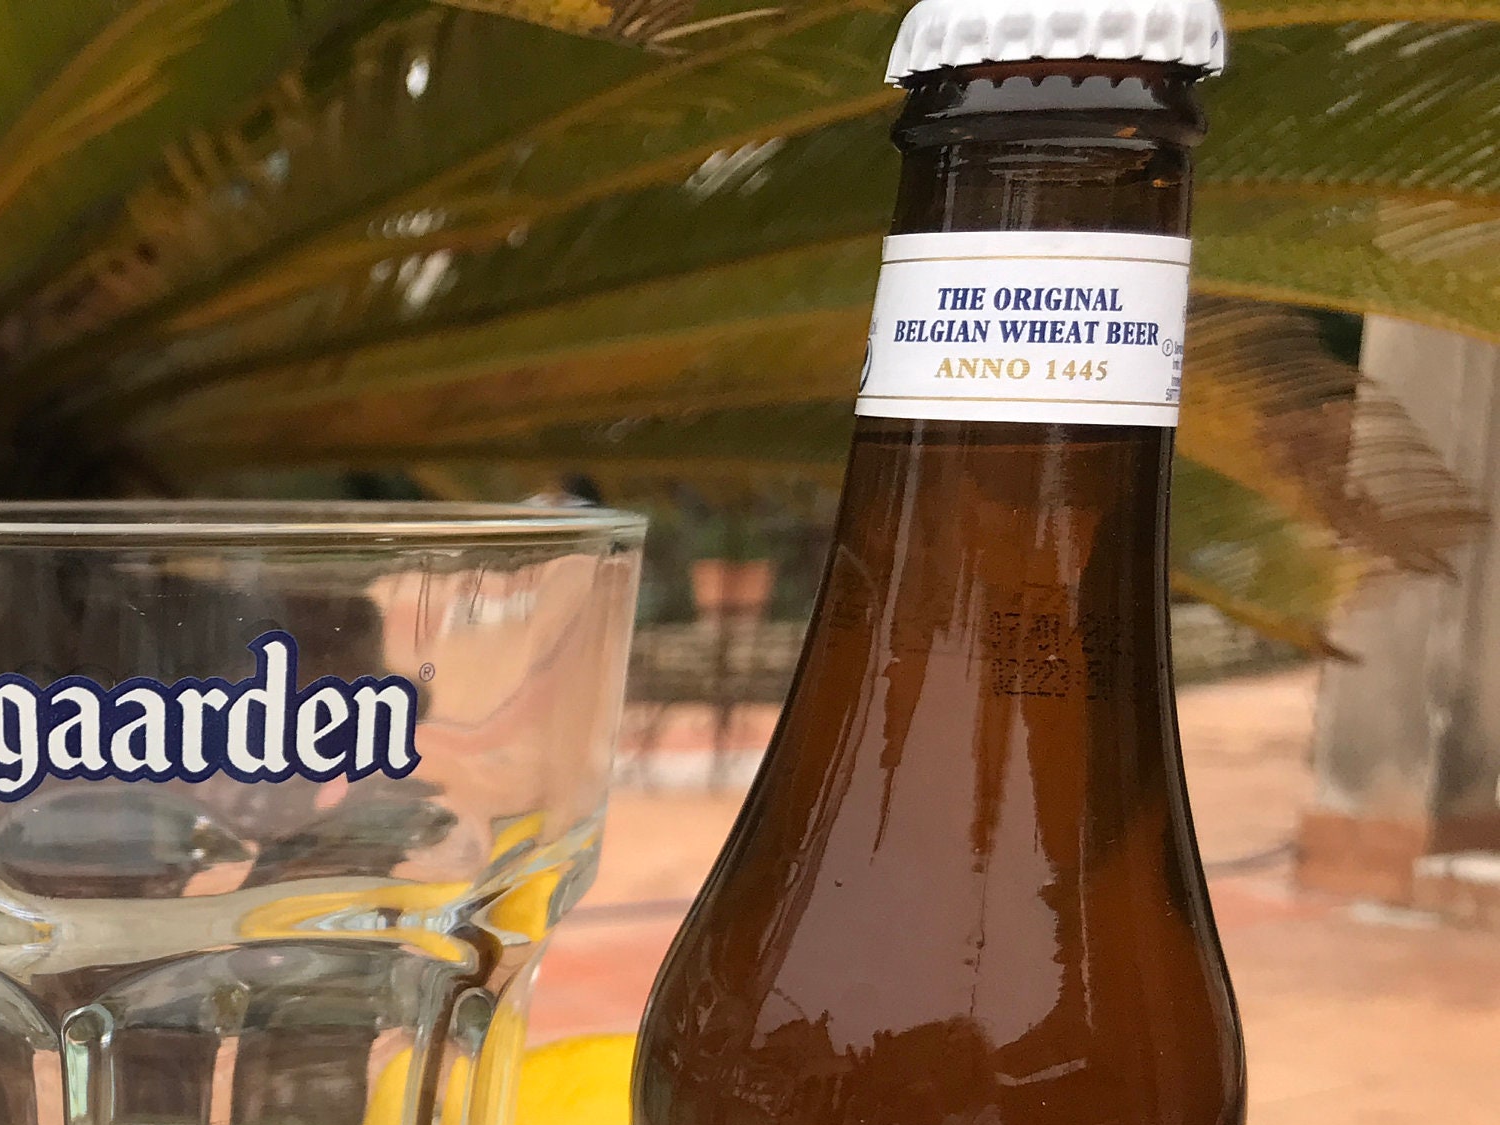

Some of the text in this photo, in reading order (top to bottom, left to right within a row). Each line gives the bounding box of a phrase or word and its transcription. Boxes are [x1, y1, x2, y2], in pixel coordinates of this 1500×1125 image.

[937, 287, 1124, 312] THE ORIGINAL
[893, 319, 1160, 346] BELGIAN WHEAT BEER
[934, 357, 1109, 381] ANNO 1445
